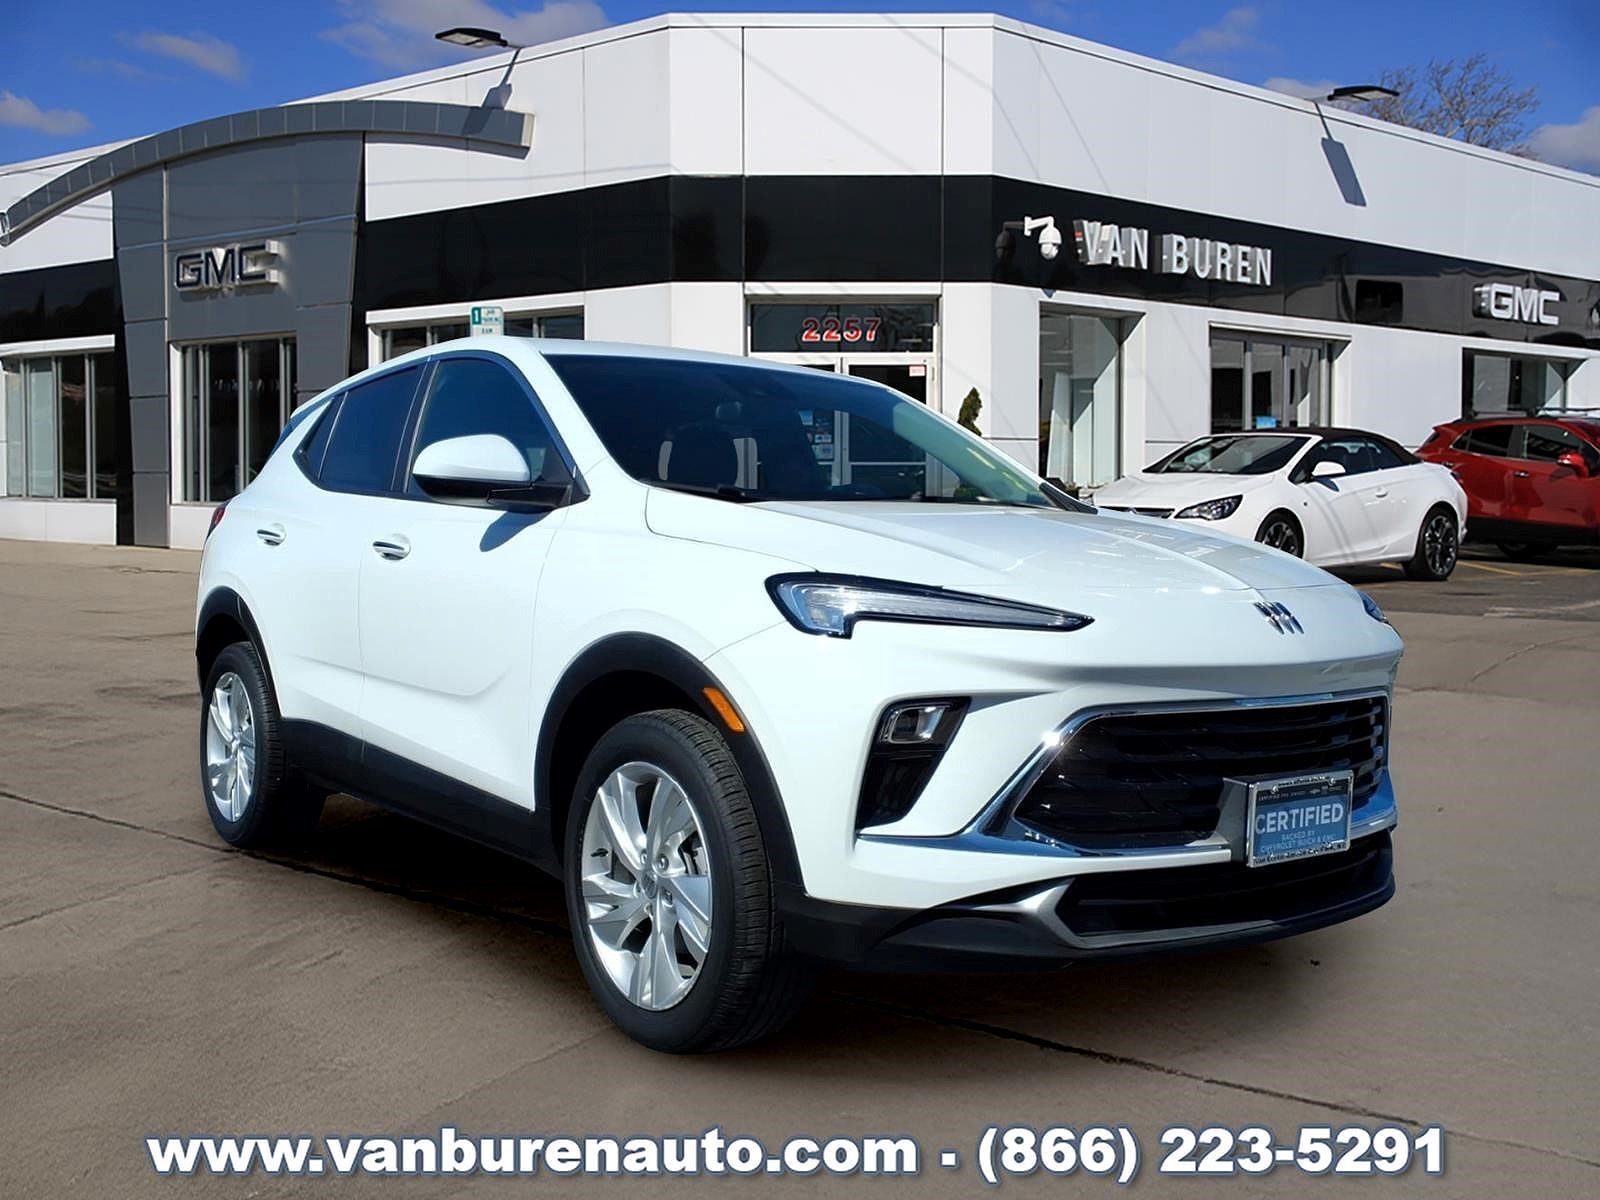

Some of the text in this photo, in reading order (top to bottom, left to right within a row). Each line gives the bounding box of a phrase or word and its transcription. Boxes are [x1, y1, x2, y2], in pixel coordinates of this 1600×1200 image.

[174, 239, 281, 291] GMC
[1078, 219, 1272, 286] VAN BUREN
[1484, 282, 1561, 326] GMC
[802, 316, 881, 342] 2257
[1255, 802, 1344, 834] CERTIFIED
